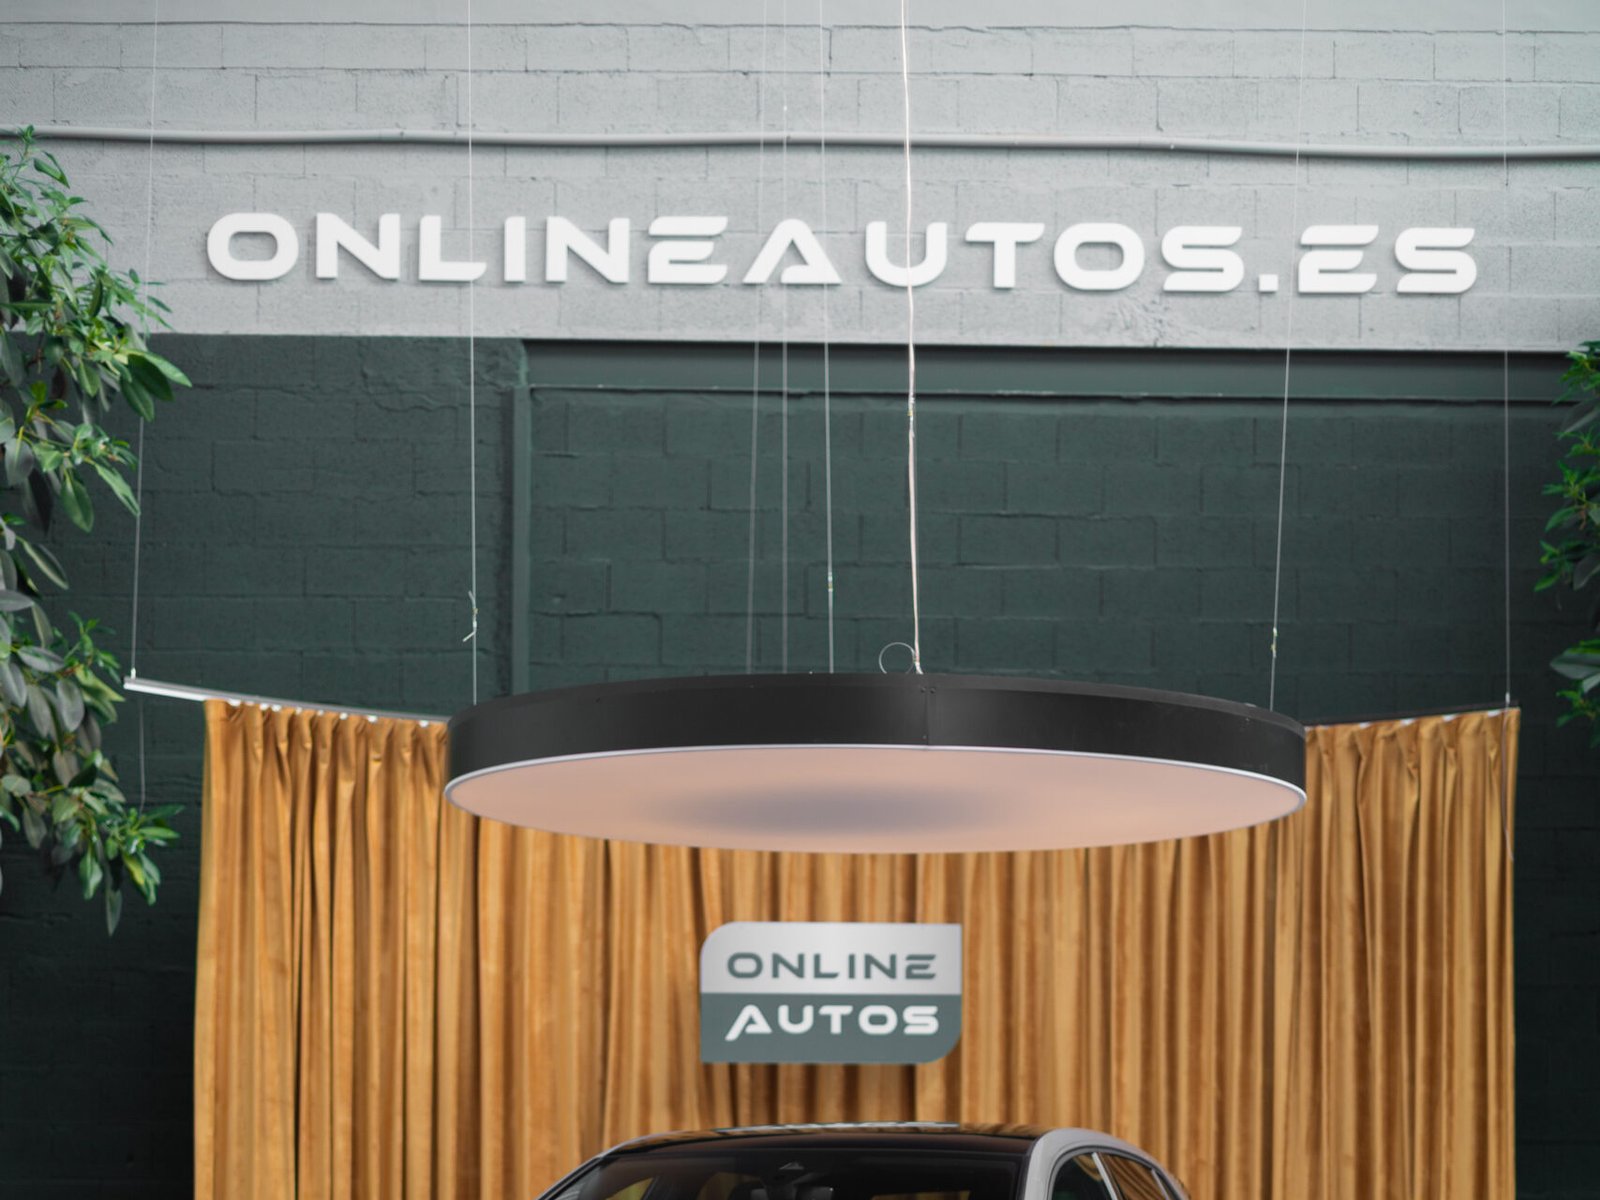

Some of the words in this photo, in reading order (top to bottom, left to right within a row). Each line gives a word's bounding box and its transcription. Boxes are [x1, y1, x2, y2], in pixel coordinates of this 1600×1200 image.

[206, 211, 1477, 295] ONLINEAUTOS.ES
[727, 952, 937, 980] ONLINE
[725, 1004, 939, 1041] AUTOS
